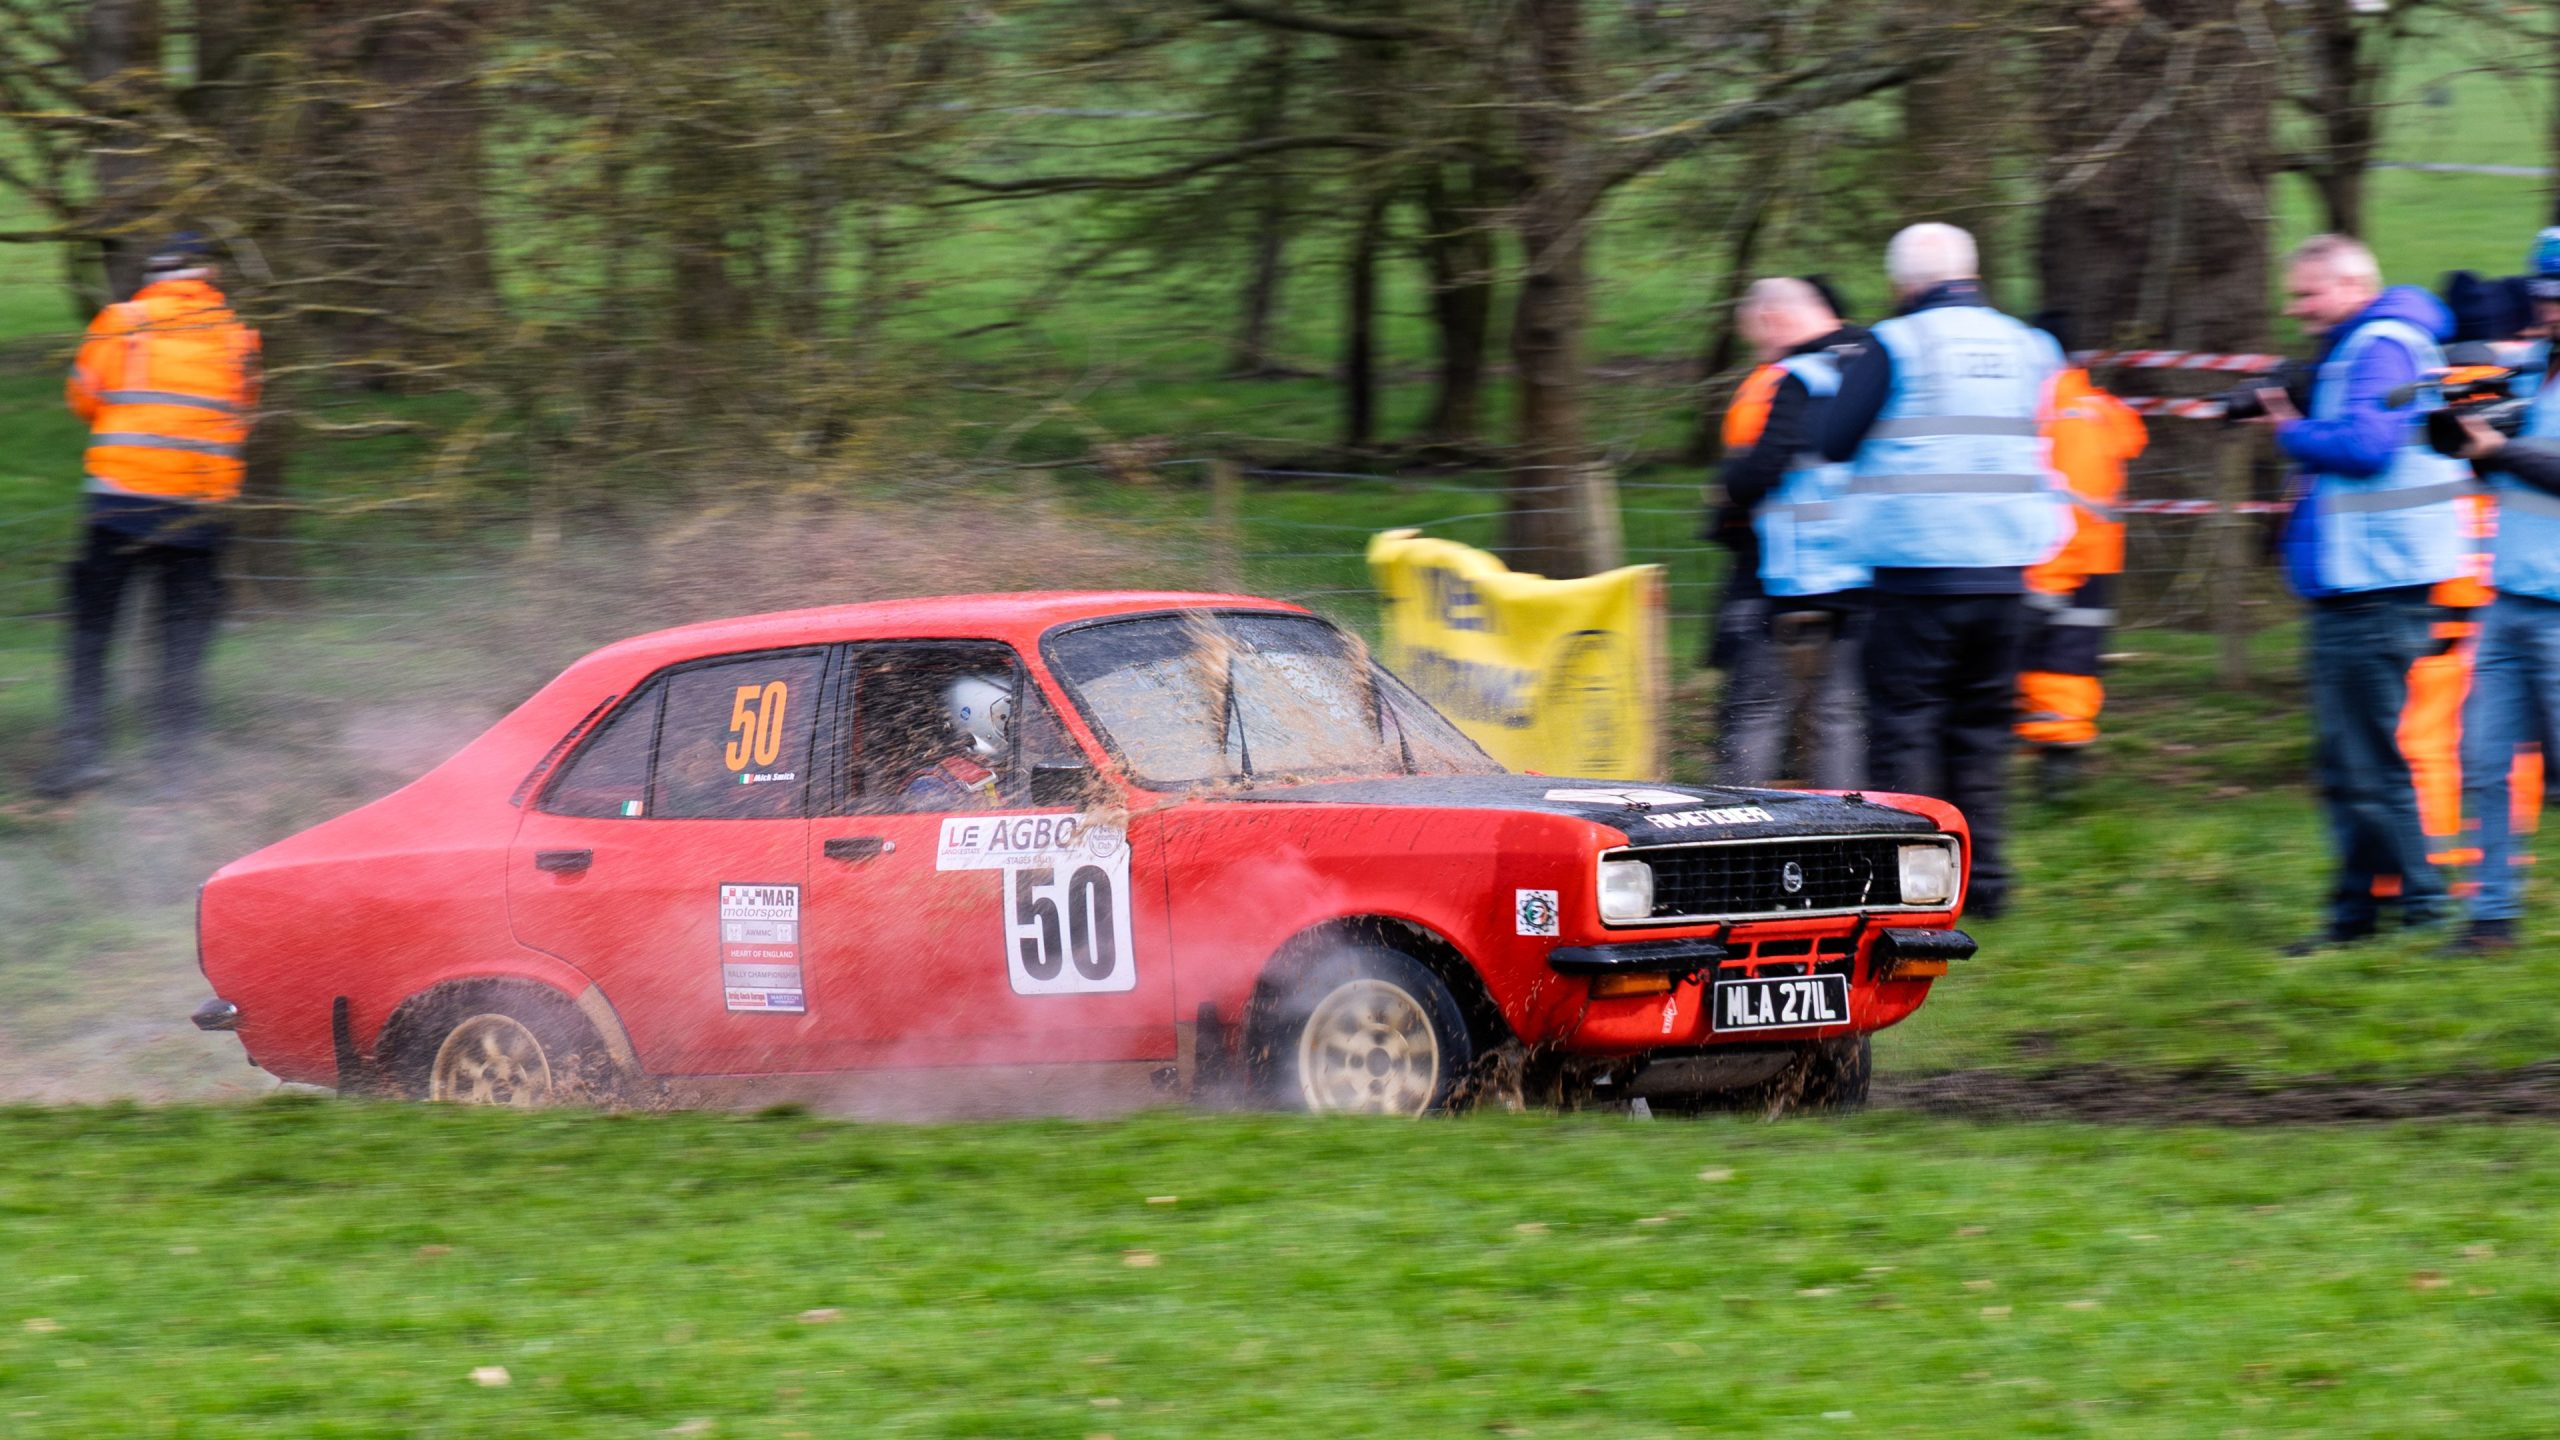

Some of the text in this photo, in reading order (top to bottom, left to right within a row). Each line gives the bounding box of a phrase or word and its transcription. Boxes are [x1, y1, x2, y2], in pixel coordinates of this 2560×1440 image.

[725, 681, 787, 771] 50
[723, 907, 793, 920] motorsport
[762, 889, 795, 907] MAR
[1016, 865, 1117, 981] 50
[730, 949, 794, 959] HEART OF ENGLAND
[1727, 981, 1837, 1026] MLA 271L
